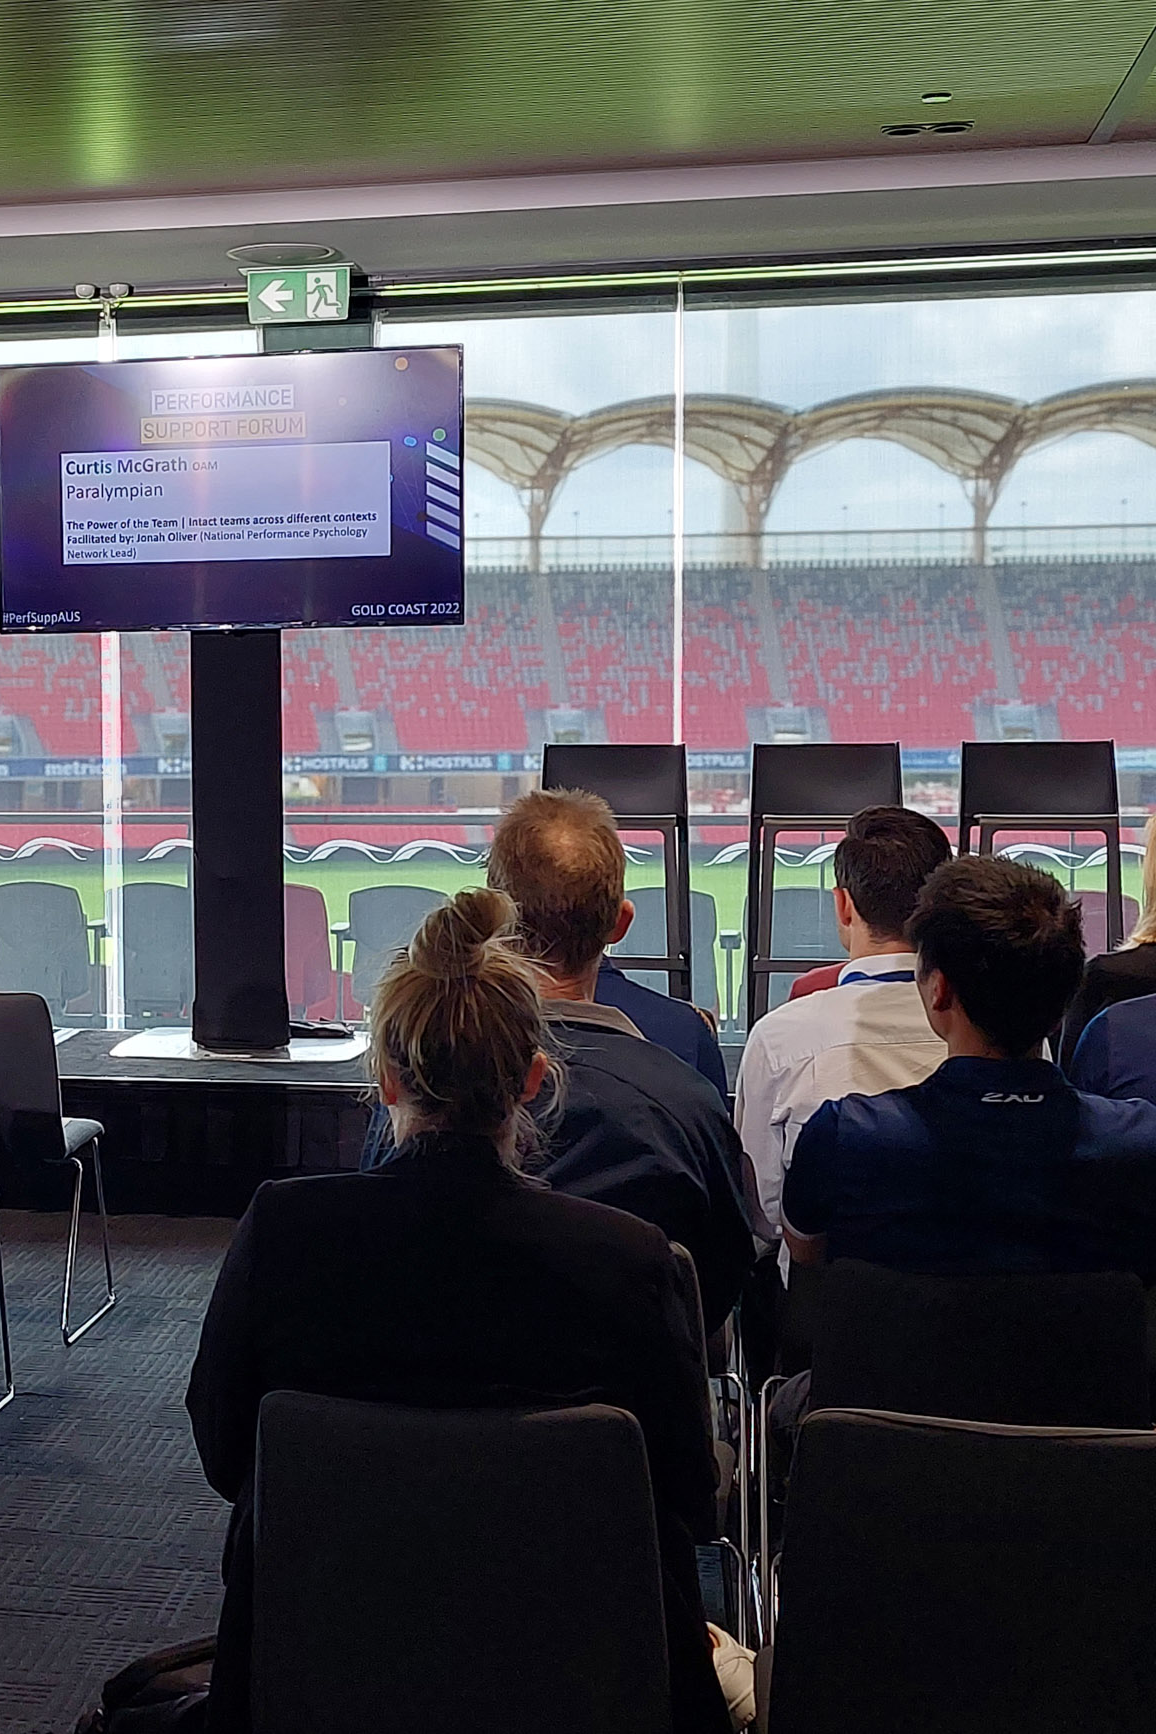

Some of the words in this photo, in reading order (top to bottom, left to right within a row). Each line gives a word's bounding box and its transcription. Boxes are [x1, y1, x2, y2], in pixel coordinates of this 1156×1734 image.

[154, 389, 292, 411] PERFORMANCE
[143, 420, 232, 440] SUPPORT
[237, 416, 304, 436] FORUM
[66, 460, 113, 476] Curtis
[117, 456, 188, 474] McGrath
[192, 461, 219, 472] OAM
[66, 482, 164, 502] Paralympian
[67, 520, 85, 531] The
[87, 520, 117, 530] Power
[120, 518, 132, 529] of
[133, 518, 149, 529] the
[152, 518, 178, 528] Team
[189, 517, 217, 527] Intact
[220, 516, 251, 526] teams
[253, 515, 285, 525] across
[287, 513, 331, 524] different
[333, 512, 377, 523] contexts
[67, 533, 117, 545] Facilitated
[136, 533, 165, 544] Jonah
[167, 531, 198, 542] Oliver
[200, 529, 245, 543] (National
[247, 528, 311, 540] Performance
[313, 526, 368, 539] Psychology
[67, 549, 108, 560] Network
[110, 547, 137, 560] Lead)
[2, 611, 81, 626] #PerfSuppAUS
[351, 604, 385, 616] GOLD
[388, 603, 428, 615] COAST
[430, 602, 460, 614] 2022
